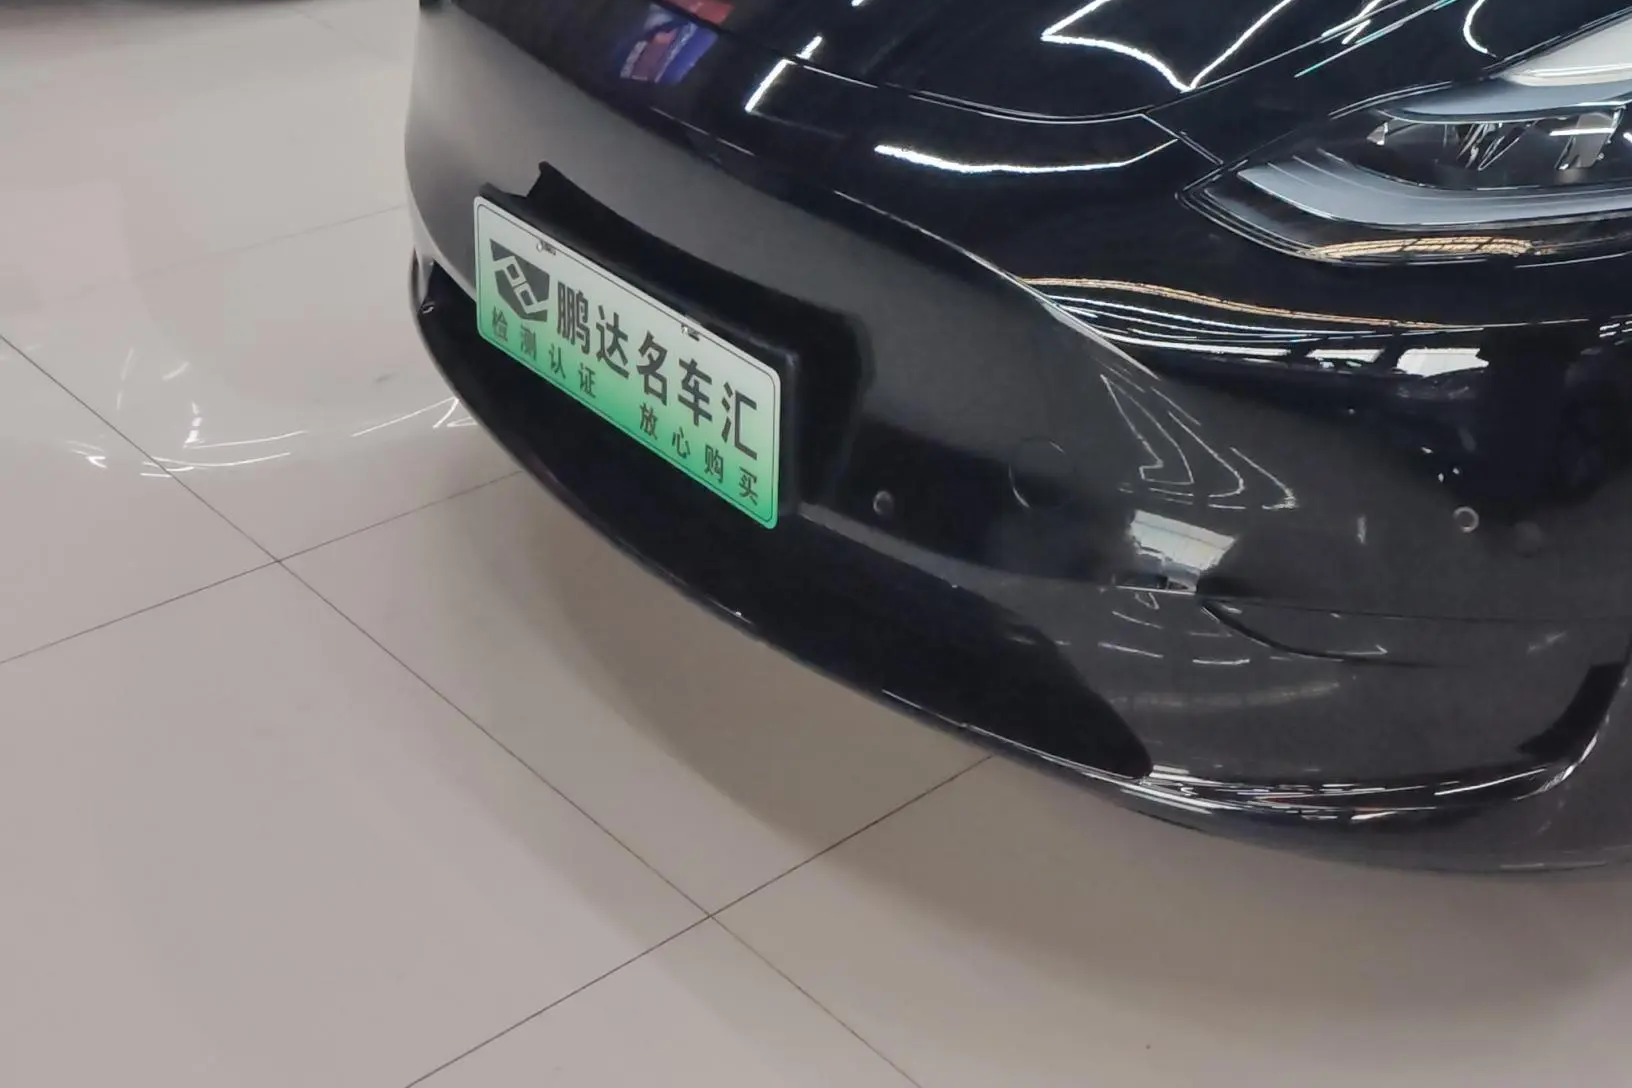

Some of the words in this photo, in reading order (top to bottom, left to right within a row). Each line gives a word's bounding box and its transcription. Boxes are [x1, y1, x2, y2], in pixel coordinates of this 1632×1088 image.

[490, 304, 597, 400] 检测认证
[638, 402, 759, 507] 放心购买
[556, 279, 759, 462] 鹏达名车汇
